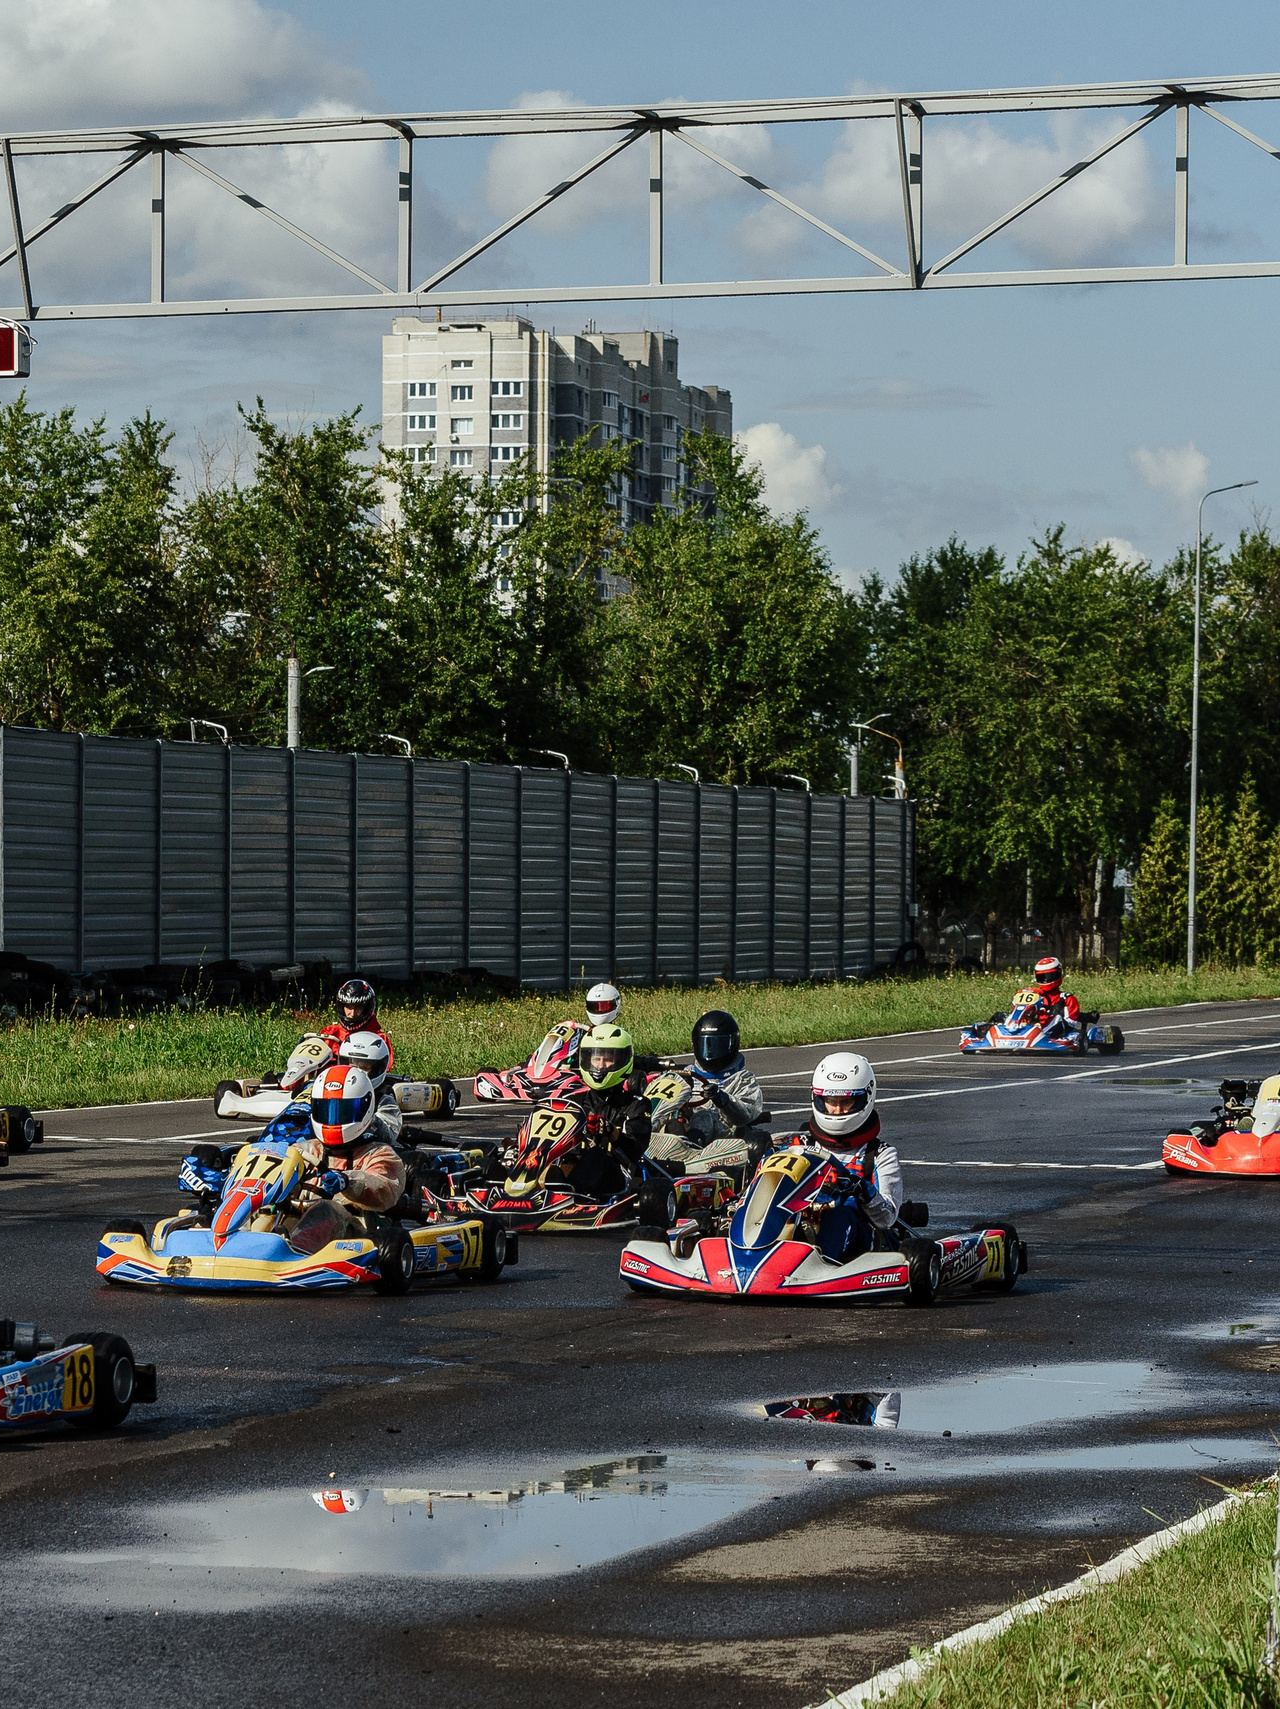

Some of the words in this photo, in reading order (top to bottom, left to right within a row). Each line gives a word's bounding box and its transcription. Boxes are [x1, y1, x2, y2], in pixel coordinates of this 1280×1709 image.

[1018, 993, 1034, 1003] 16
[550, 1026, 569, 1036] 26
[299, 1044, 322, 1056] 78
[646, 1081, 676, 1099] 44
[534, 1114, 566, 1137] 79
[244, 1155, 283, 1179] 17
[767, 1156, 798, 1171] 71
[463, 1226, 479, 1266] 17
[987, 1240, 1000, 1273] 71
[67, 1353, 93, 1407] 18
